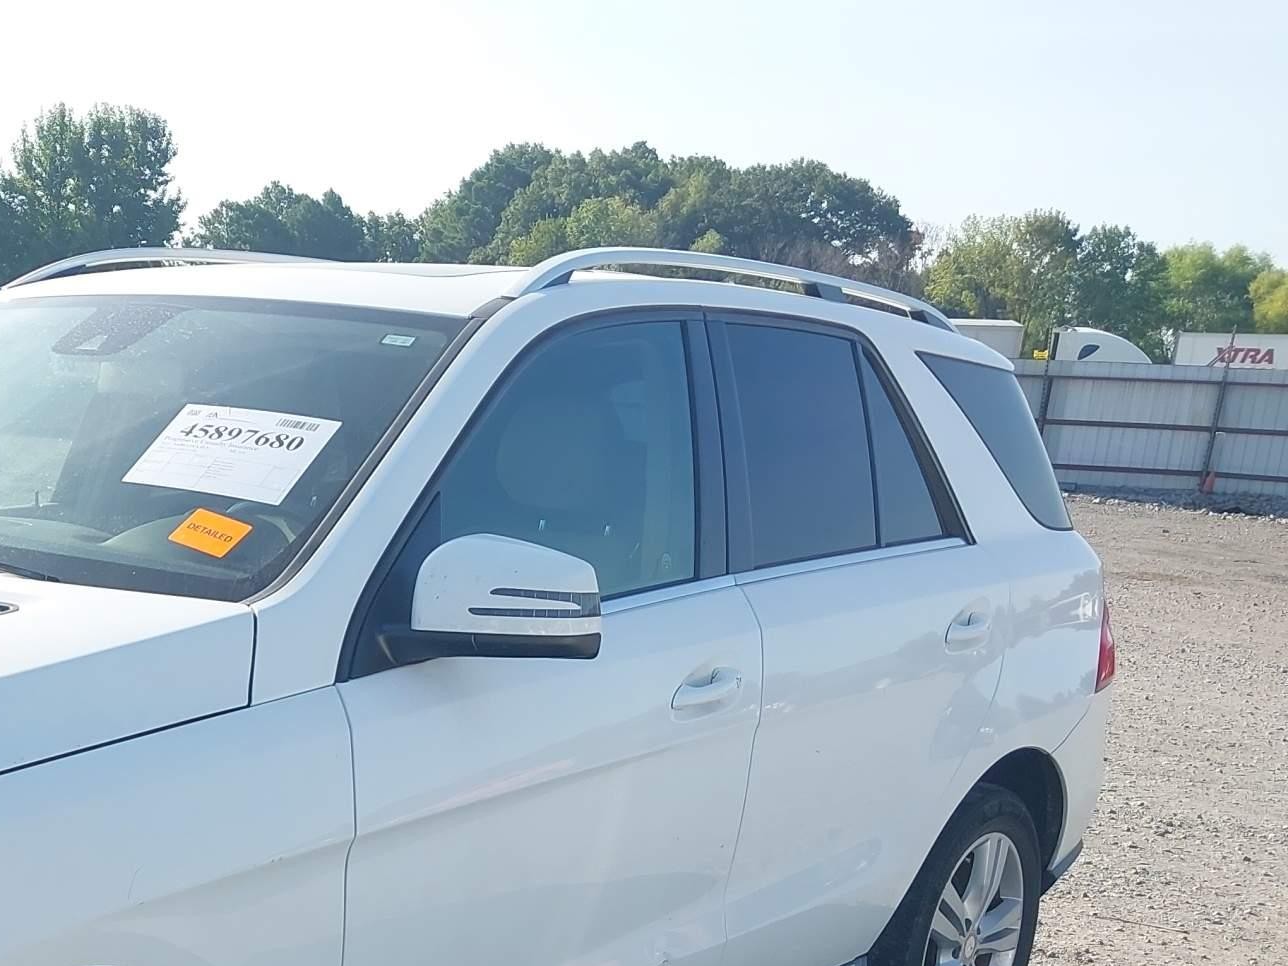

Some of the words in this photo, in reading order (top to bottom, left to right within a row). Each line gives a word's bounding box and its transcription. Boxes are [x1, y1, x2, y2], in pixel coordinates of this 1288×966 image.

[1216, 347, 1274, 364] XTRA
[179, 422, 305, 452] 45897680
[186, 522, 234, 543] DETAILED
